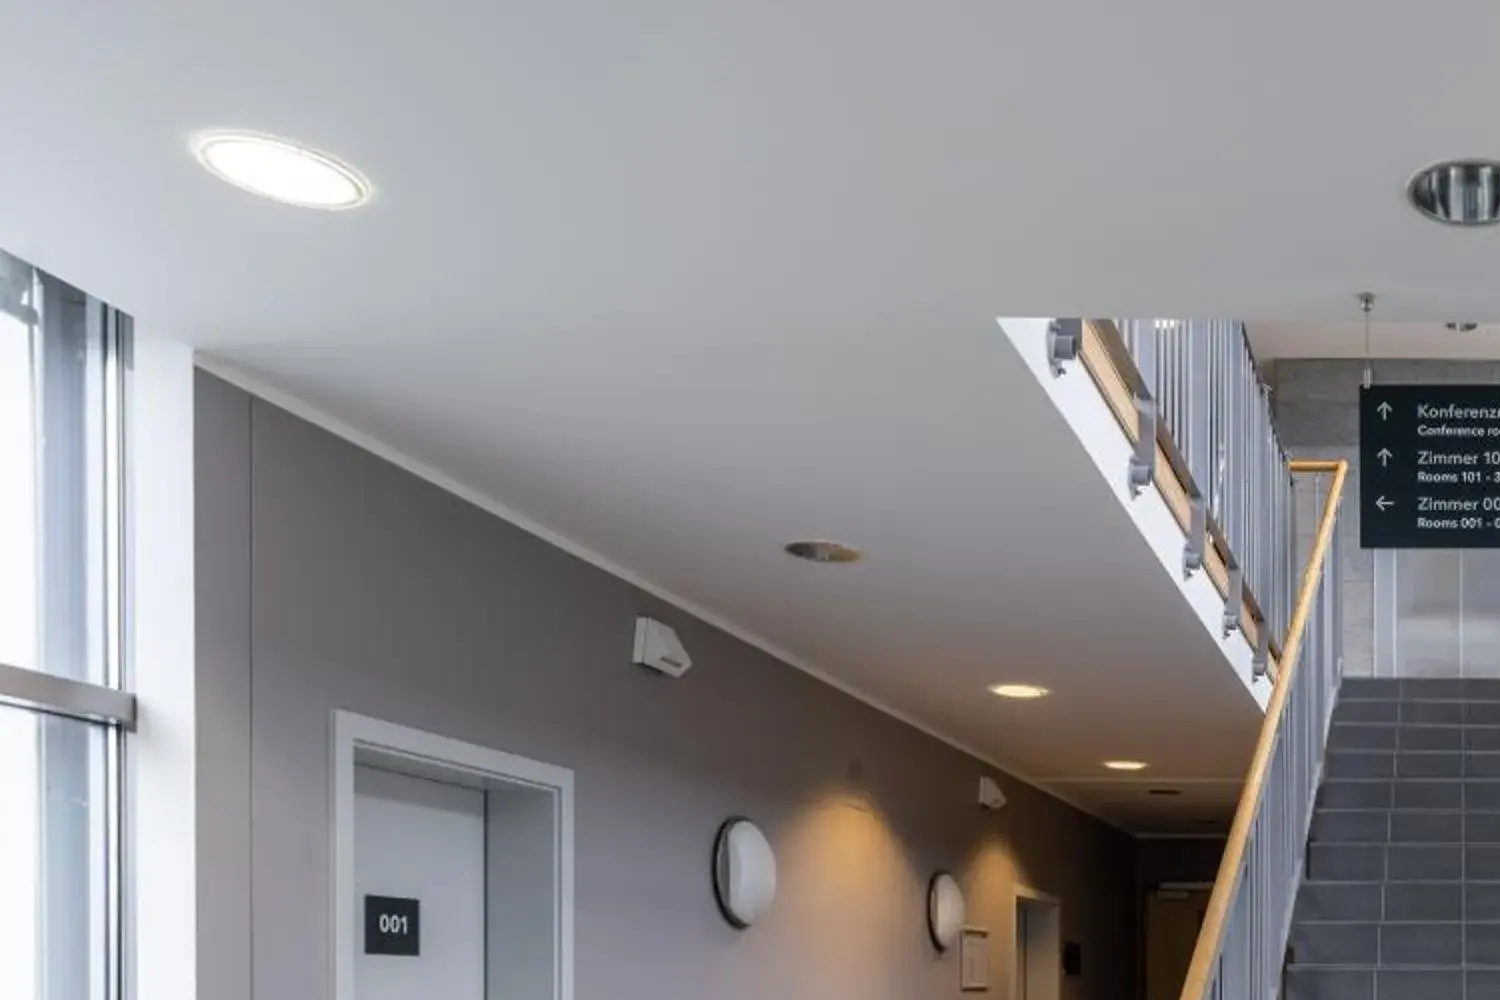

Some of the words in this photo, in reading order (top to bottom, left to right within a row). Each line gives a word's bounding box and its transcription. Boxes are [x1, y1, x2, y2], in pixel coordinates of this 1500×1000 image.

[1417, 423, 1485, 437] Conference
[1417, 450, 1479, 465] Zimmer
[1417, 471, 1459, 483] Rooms
[1461, 471, 1482, 483] 101
[1417, 496, 1479, 511] Zimmer
[1417, 517, 1459, 529] Rooms
[1460, 517, 1483, 529] 001
[379, 913, 408, 935] 001
